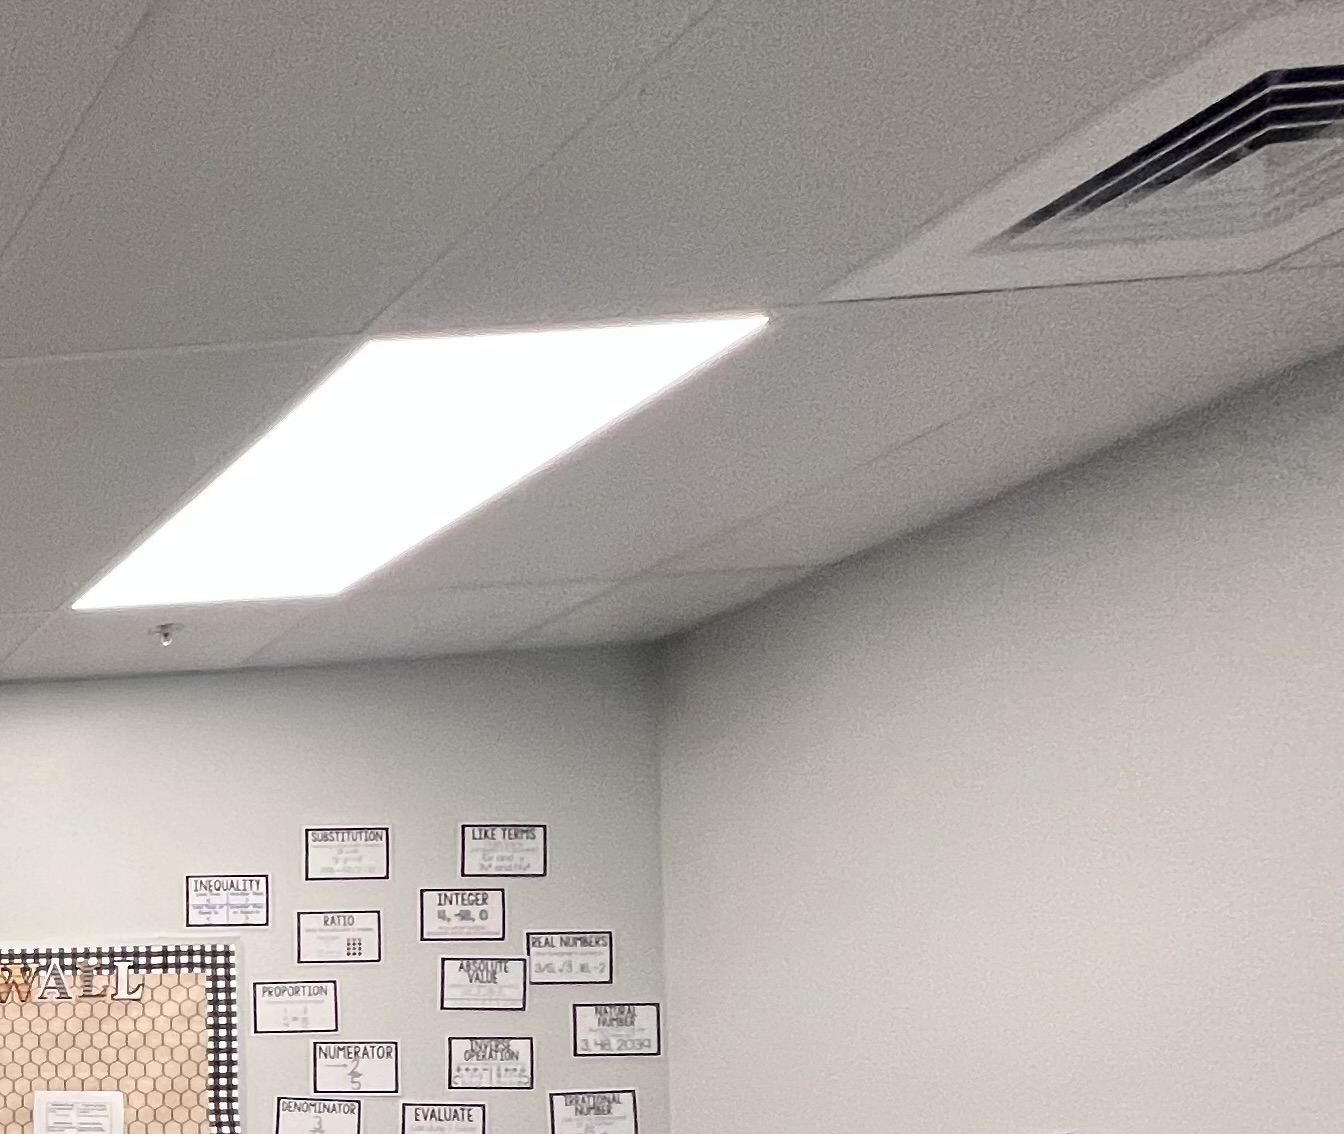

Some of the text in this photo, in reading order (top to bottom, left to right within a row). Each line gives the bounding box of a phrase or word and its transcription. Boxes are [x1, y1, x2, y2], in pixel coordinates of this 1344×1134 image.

[310, 831, 384, 843] SUBSTITUTION
[471, 827, 537, 841] LIKE TERMS
[193, 879, 261, 893] INEQUALITY
[436, 891, 489, 906] INTEGER
[323, 914, 355, 927] RATIO
[531, 935, 609, 949] REAL NUMBERS
[458, 959, 510, 974] ABSOLUTE
[467, 970, 498, 984] VALUE
[261, 985, 329, 998] PROPORTION
[594, 1005, 638, 1017] NATURAL
[597, 1016, 636, 1028] NUMBER
[318, 1045, 394, 1060] NUMERATOR
[469, 1039, 511, 1052] INVERSE
[463, 1049, 520, 1062] OPERATION
[564, 1093, 624, 1107] IRRATIONAL
[280, 1100, 357, 1115] DENOMINATOR
[414, 1107, 474, 1122] EVALUATE
[574, 1104, 613, 1117] NUMBER
